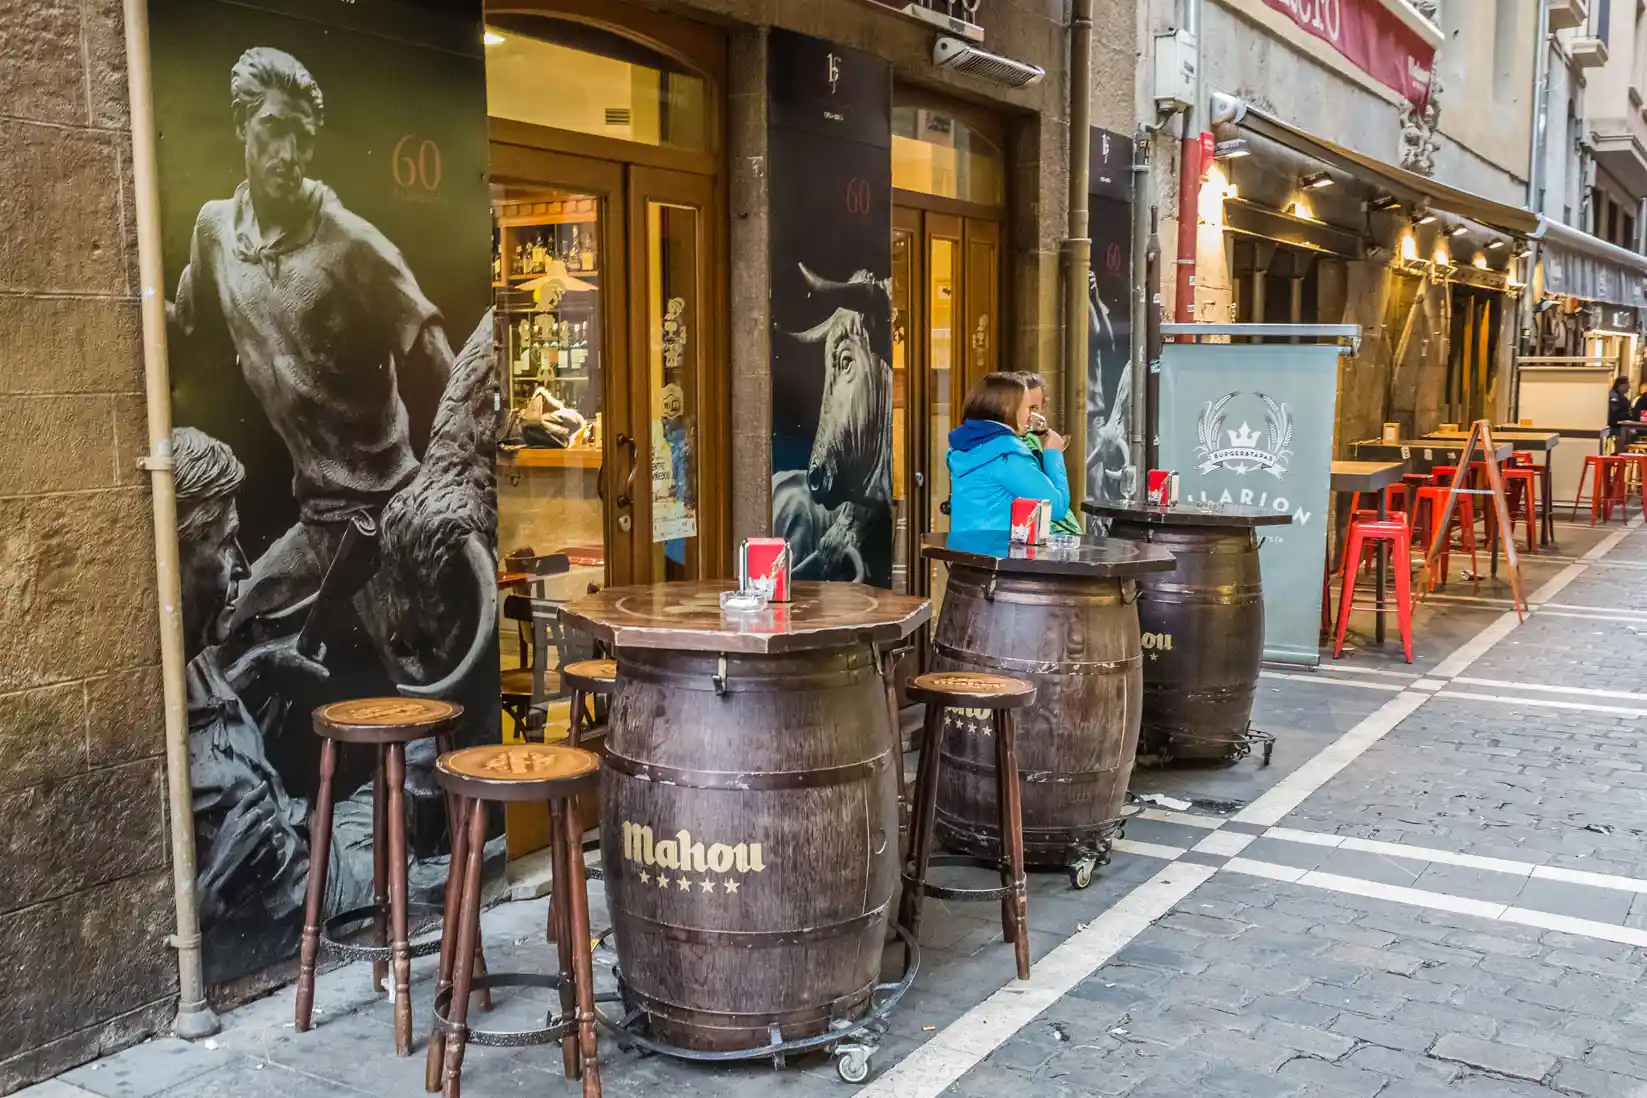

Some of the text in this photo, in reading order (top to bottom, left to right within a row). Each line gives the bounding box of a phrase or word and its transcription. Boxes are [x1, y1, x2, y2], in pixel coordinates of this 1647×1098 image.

[392, 133, 442, 191] 60
[846, 176, 870, 215] 60
[623, 820, 766, 873] Mahou
